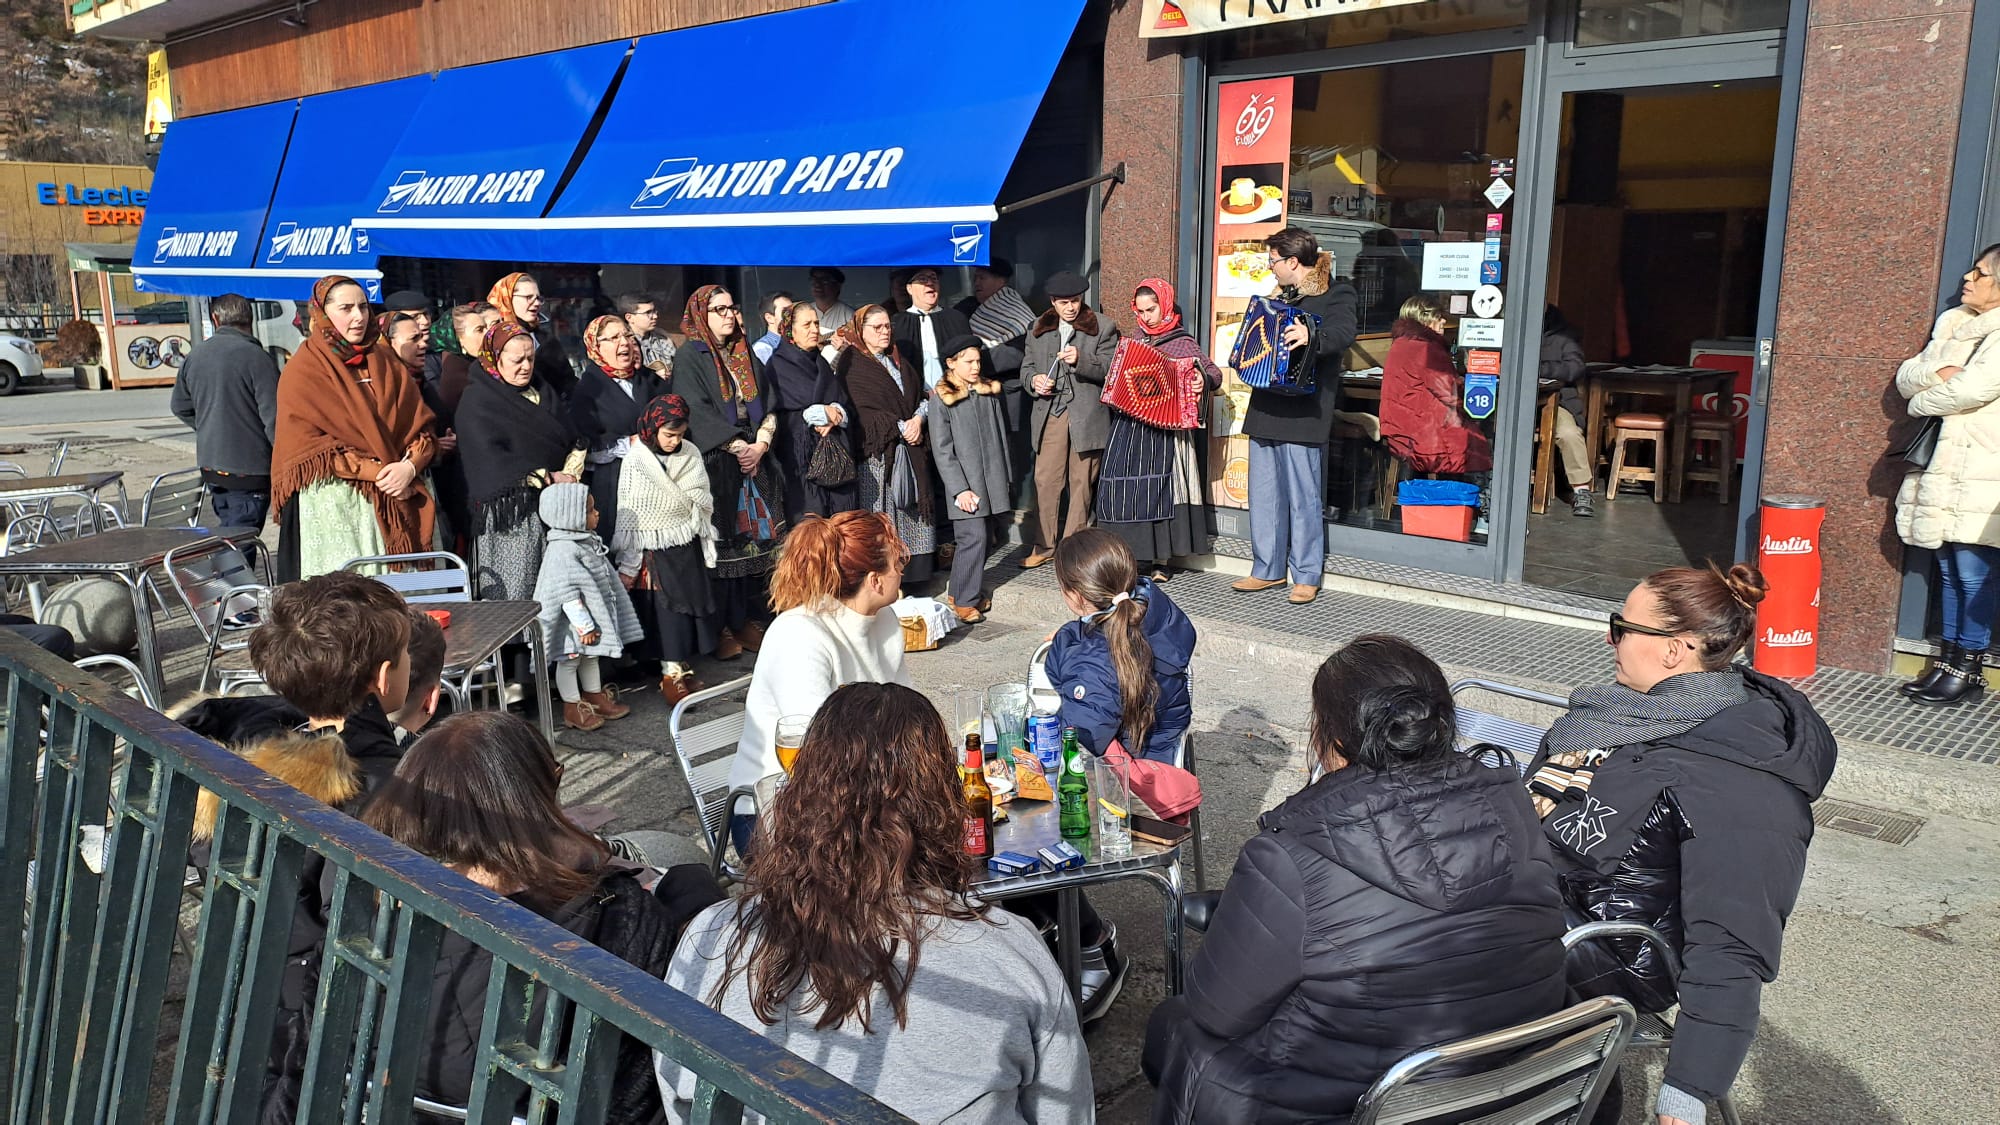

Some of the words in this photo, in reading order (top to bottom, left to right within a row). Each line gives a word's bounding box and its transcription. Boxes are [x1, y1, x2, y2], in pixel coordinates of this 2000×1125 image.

[1162, 12, 1183, 21] DELTA
[676, 158, 787, 200] NATUR
[780, 146, 904, 195] PAPER
[406, 174, 479, 206] NATUR
[468, 168, 546, 204] PAPER
[168, 231, 204, 257] NATUR
[200, 230, 239, 257] PAPER
[286, 226, 334, 257] NATUR
[329, 224, 352, 255] PA
[1467, 394, 1490, 408] +18
[1761, 534, 1814, 555] Austin
